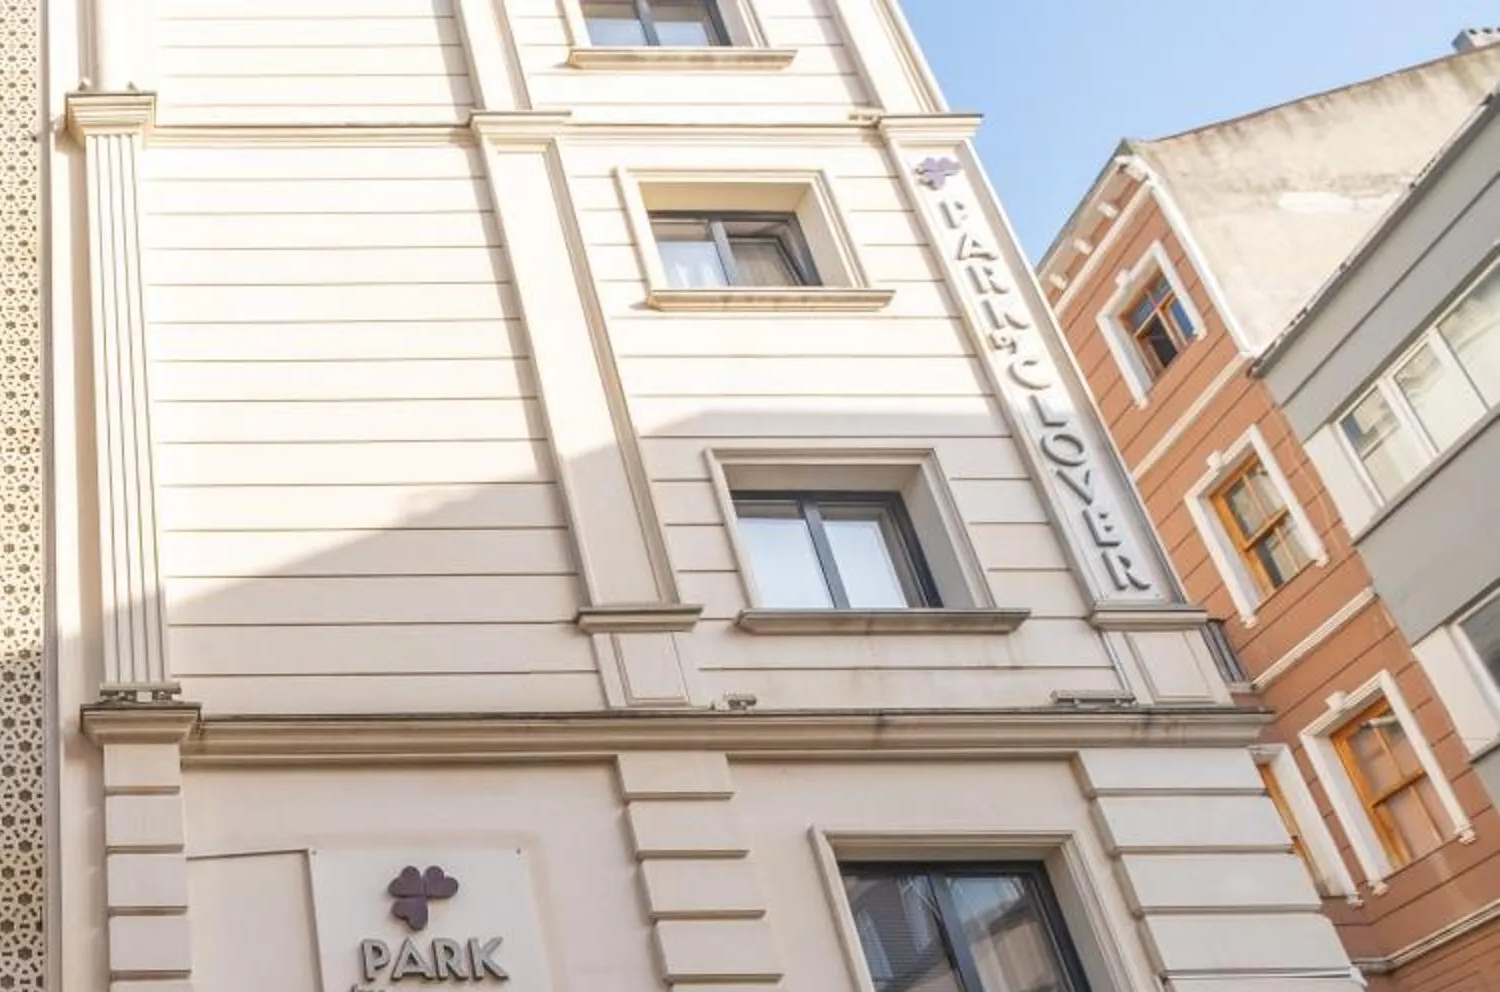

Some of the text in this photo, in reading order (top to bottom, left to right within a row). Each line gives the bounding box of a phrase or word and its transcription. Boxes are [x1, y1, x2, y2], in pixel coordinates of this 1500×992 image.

[938, 200, 1031, 330] PARK
[1009, 358, 1152, 592] CLOVER
[361, 937, 509, 982] PARK
